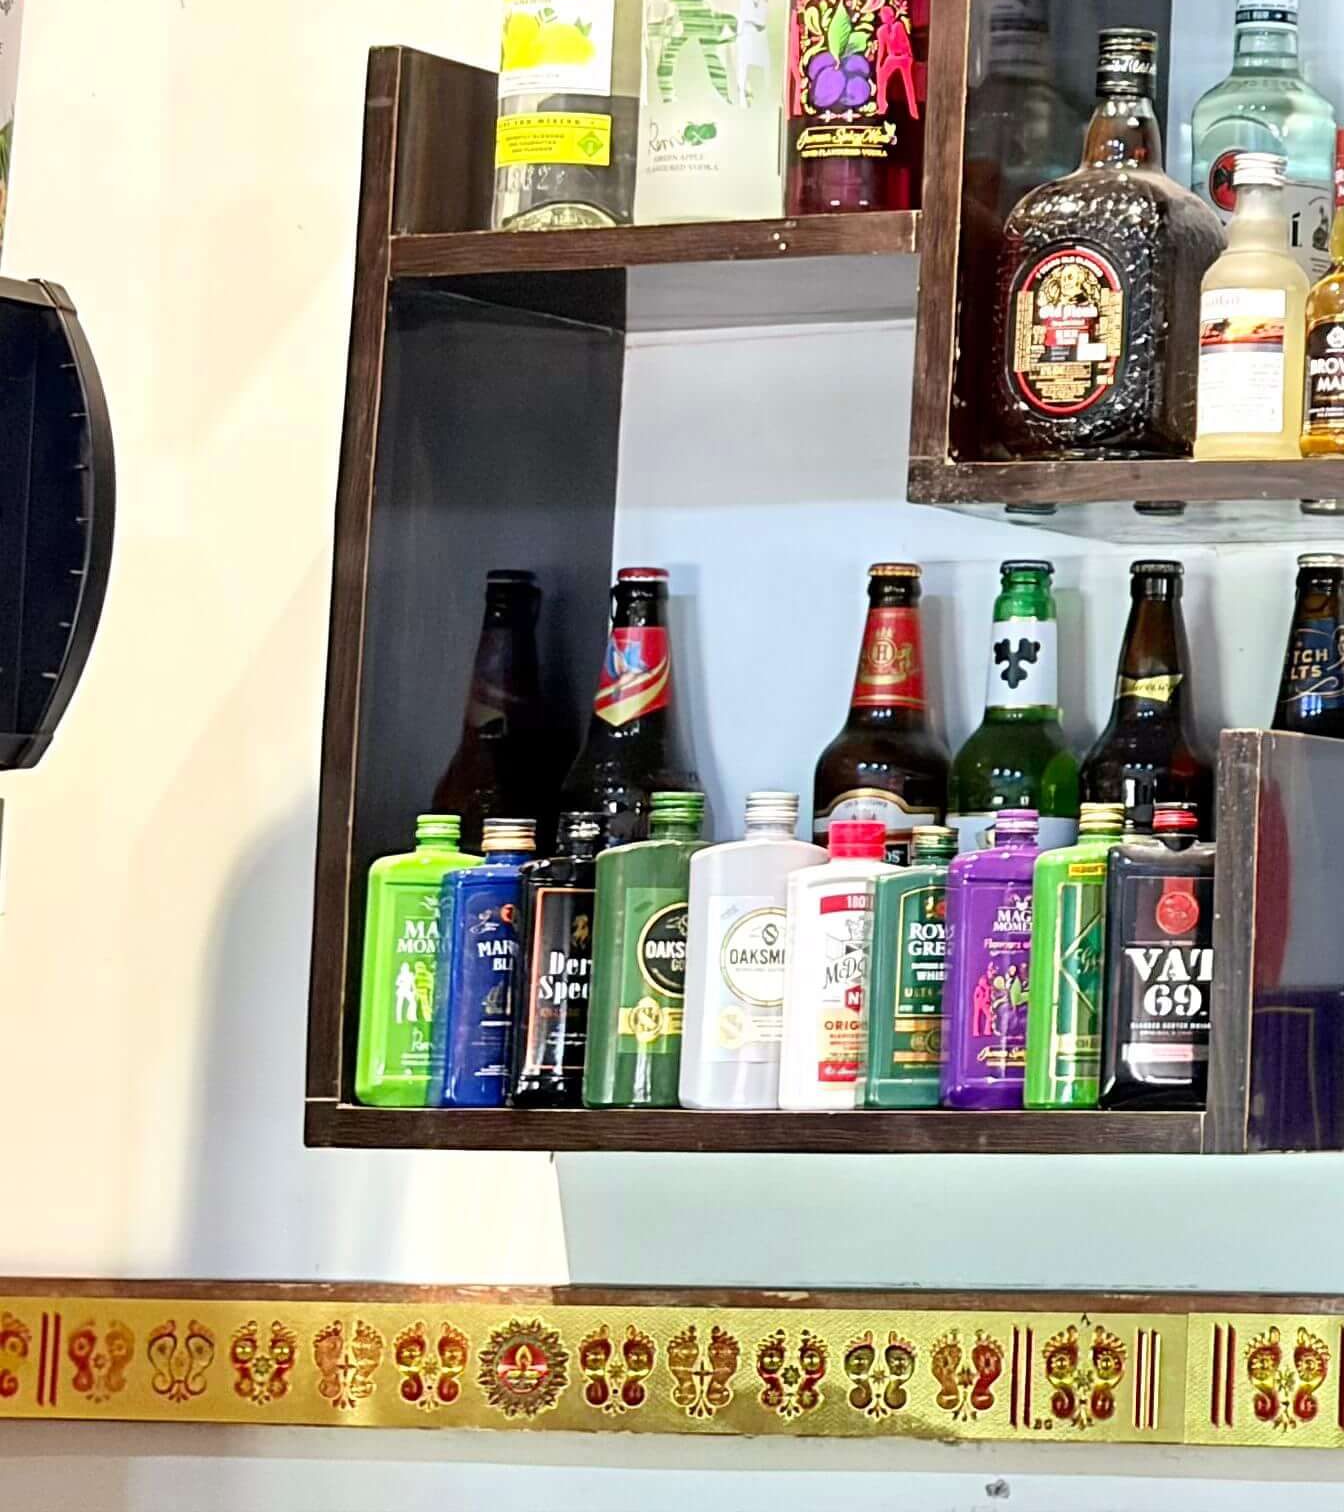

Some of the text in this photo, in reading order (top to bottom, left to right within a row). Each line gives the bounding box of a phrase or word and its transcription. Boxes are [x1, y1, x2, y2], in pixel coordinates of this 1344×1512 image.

[876, 645, 887, 661] H
[997, 909, 1032, 923] MAG
[646, 940, 686, 959] OAKS
[730, 949, 786, 965] OAKSMI
[549, 951, 592, 976] Der
